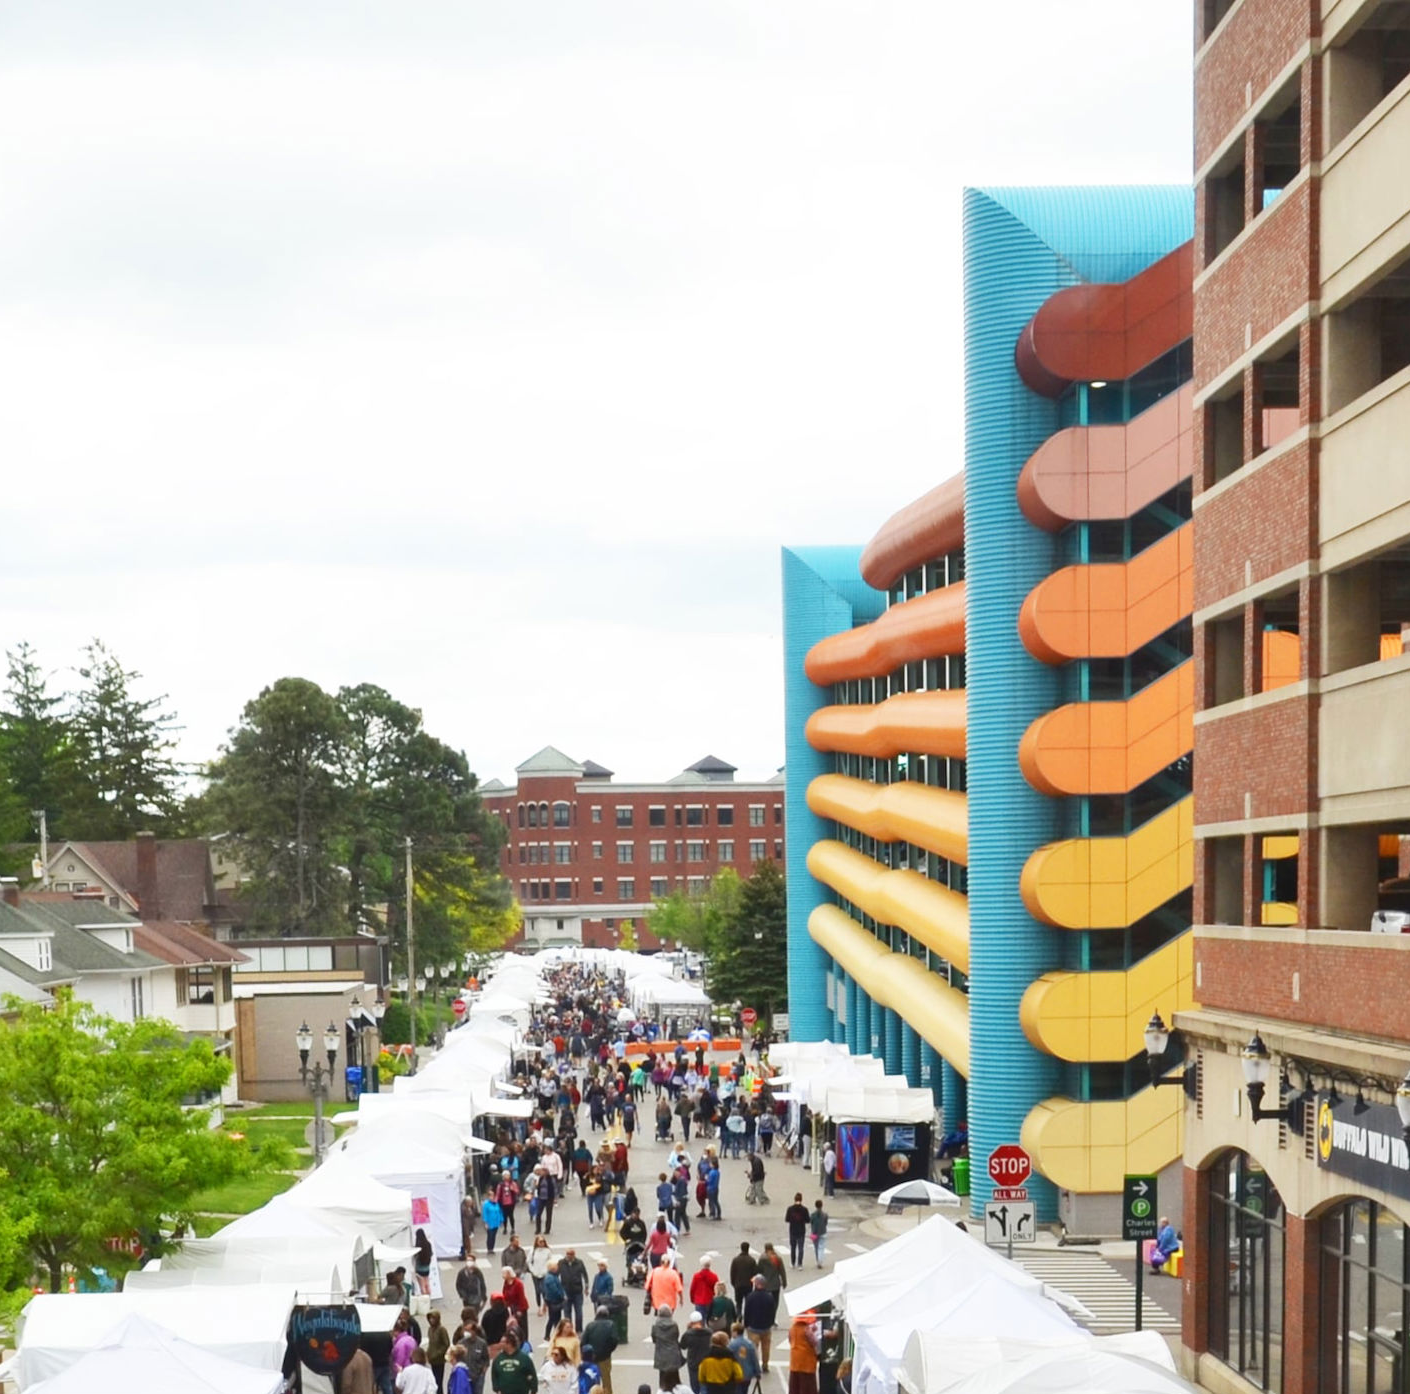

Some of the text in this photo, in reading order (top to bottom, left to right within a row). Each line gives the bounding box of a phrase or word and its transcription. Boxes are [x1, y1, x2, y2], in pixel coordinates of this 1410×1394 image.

[1368, 1130, 1390, 1164] WILD
[991, 1157, 1029, 1175] STOP
[994, 1190, 1026, 1199] ALL WAY
[1126, 1218, 1156, 1228] Charles
[1013, 1232, 1033, 1241] ONLY
[1129, 1229, 1153, 1237] Street
